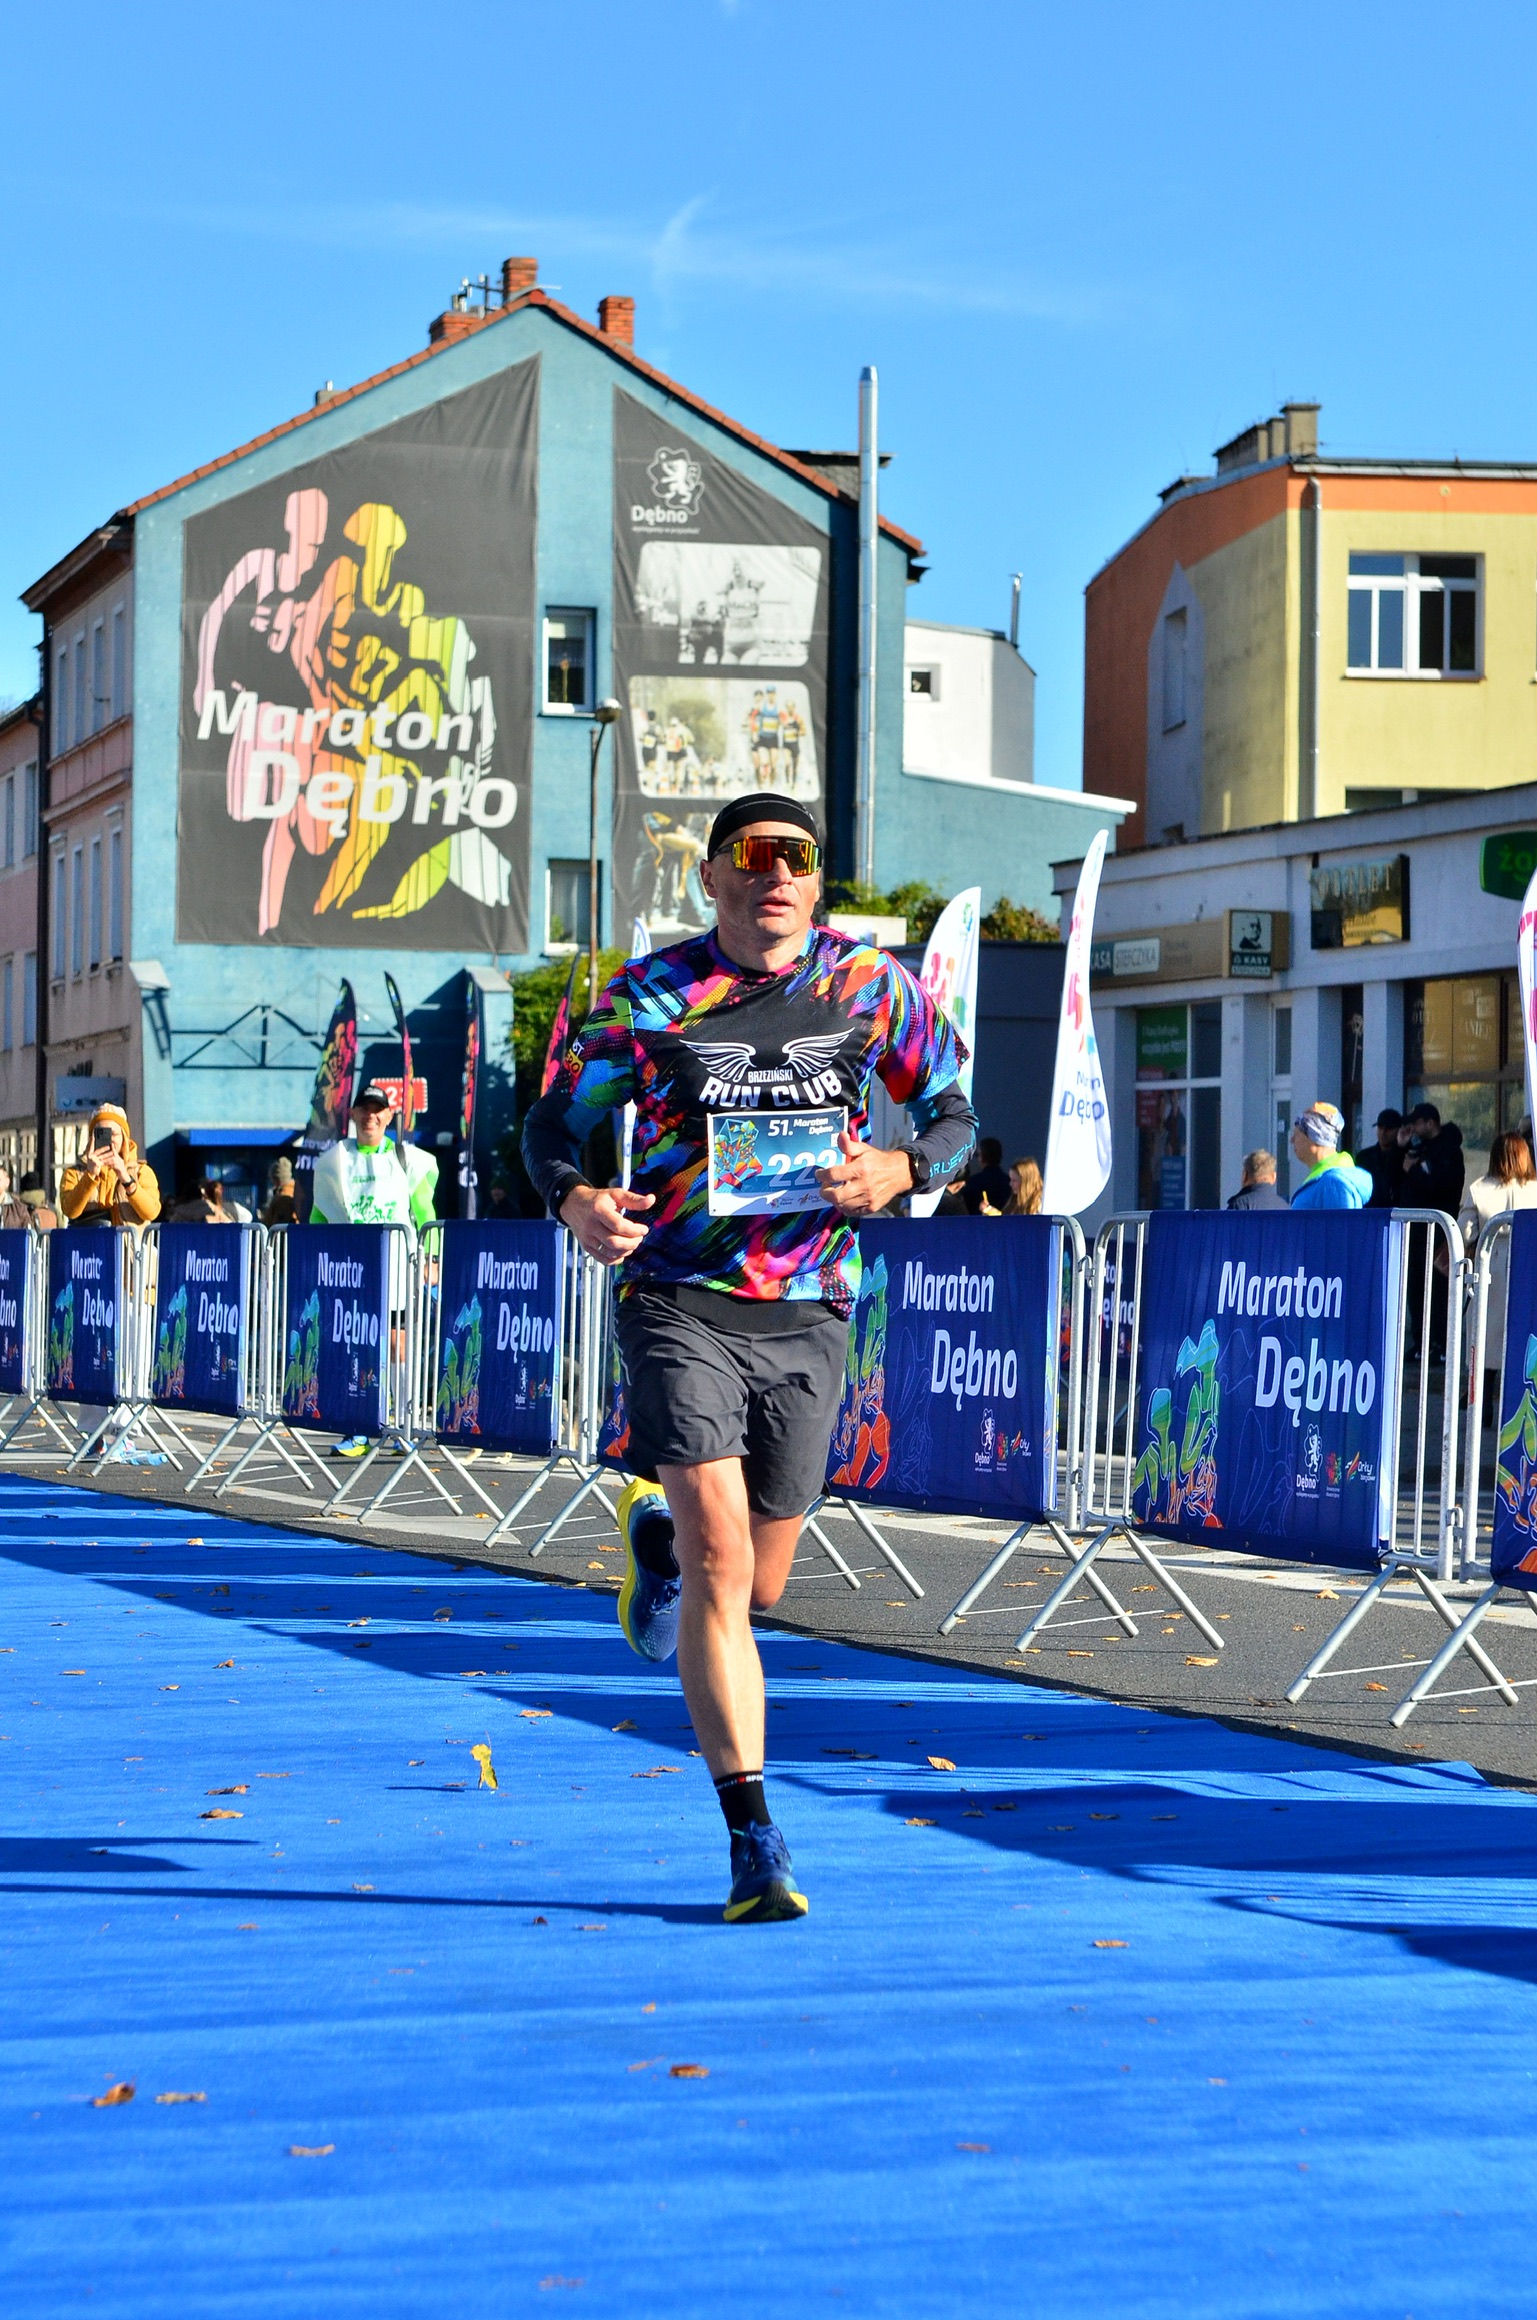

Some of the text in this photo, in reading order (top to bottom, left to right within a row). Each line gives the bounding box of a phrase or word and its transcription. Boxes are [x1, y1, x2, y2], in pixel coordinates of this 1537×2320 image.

[631, 505, 688, 526] Dębno
[197, 690, 474, 751] Maraton
[243, 751, 518, 838] Dębno
[1092, 950, 1112, 970] ASA
[699, 1069, 842, 1108] RUN CLUB
[748, 1067, 793, 1083] BRZEZIŃSKI
[768, 1118, 828, 1136] 51. Maraton
[477, 1252, 539, 1291] Maraton
[903, 1261, 995, 1313] Maraton
[1217, 1261, 1343, 1319] Maraton
[496, 1302, 553, 1364] Dębno
[930, 1329, 1018, 1411] Dębno
[1255, 1336, 1376, 1427] Dębno
